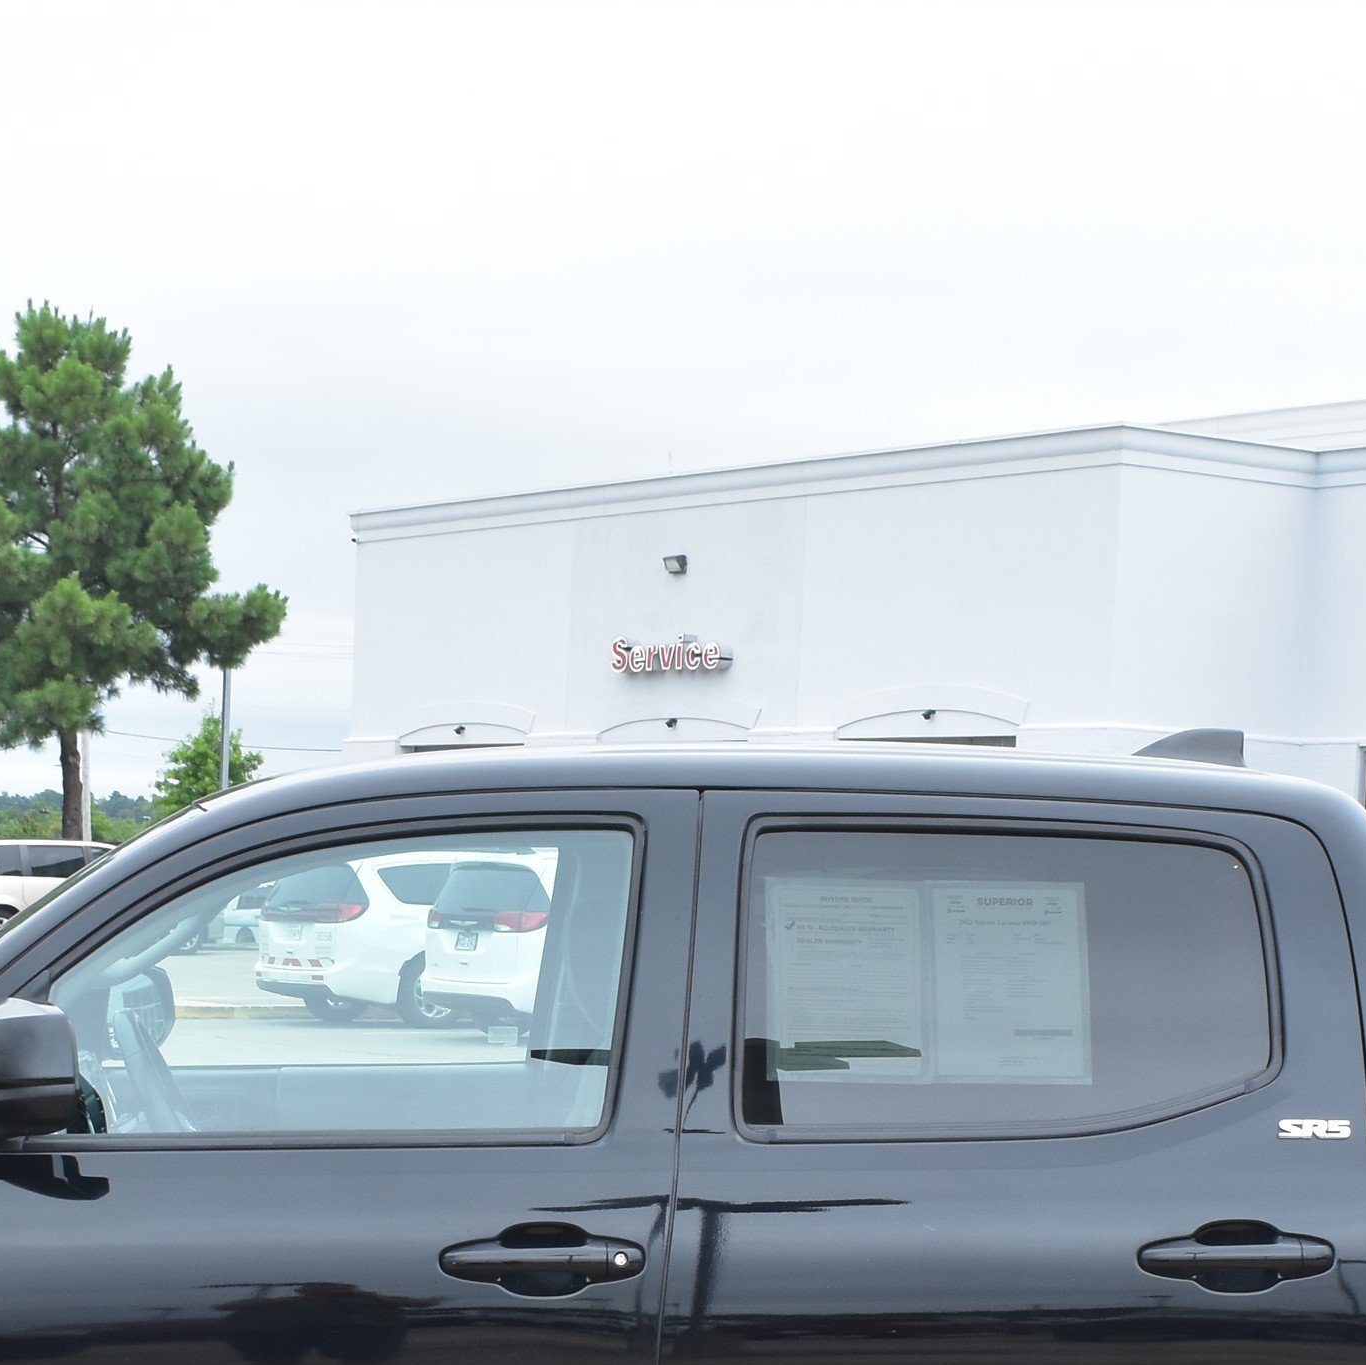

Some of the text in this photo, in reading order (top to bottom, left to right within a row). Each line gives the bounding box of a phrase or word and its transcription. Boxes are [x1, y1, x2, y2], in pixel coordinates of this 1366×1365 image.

[611, 633, 723, 673] Service
[977, 897, 1033, 907] SUPERIOR
[1278, 1118, 1352, 1140] SR5
